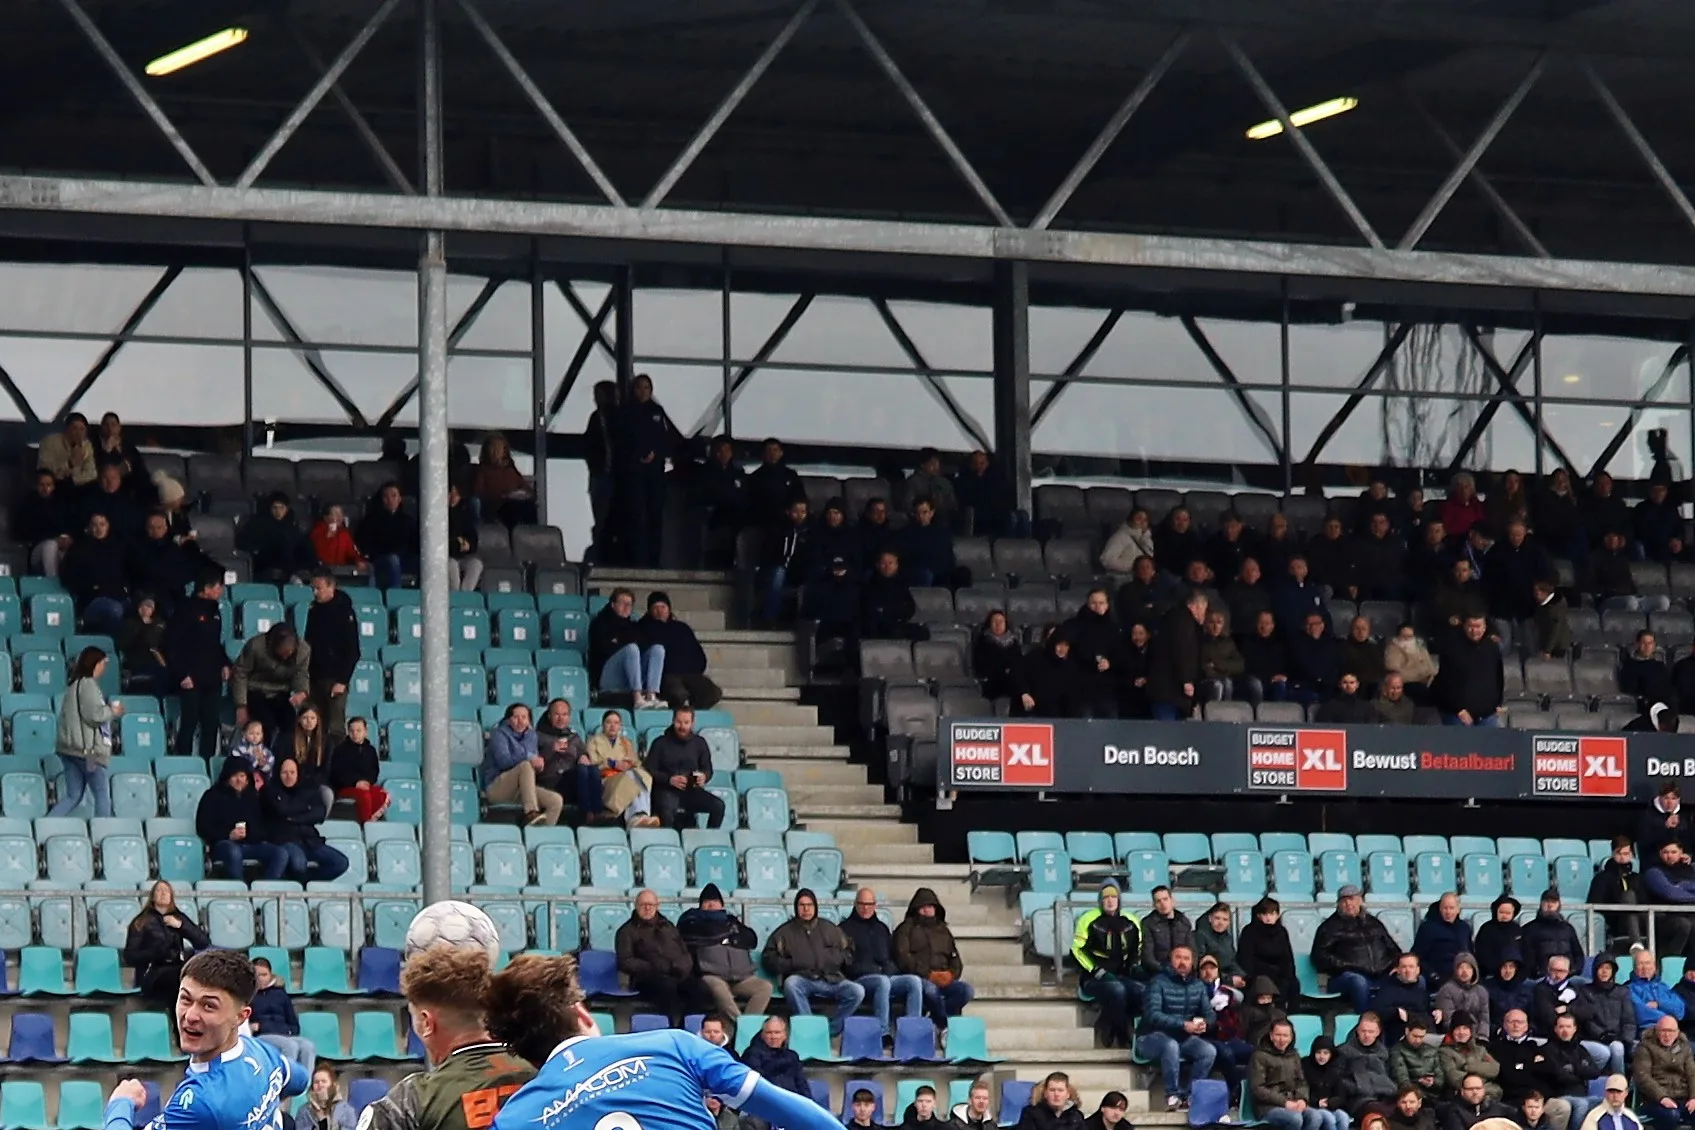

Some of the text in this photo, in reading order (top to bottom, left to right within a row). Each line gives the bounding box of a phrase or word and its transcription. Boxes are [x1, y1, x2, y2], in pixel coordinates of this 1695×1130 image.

[955, 728, 999, 740] BUDGET
[1252, 733, 1295, 746] BUDGET
[955, 747, 1000, 761] HOME
[1536, 740, 1578, 753] BUDGET
[1007, 743, 1049, 767] XL
[1104, 744, 1200, 766] Den Bosch
[1252, 751, 1295, 766] HOME
[1301, 748, 1342, 771] XL
[1353, 750, 1515, 771] Bewust Betaalbaar!
[1536, 758, 1578, 772] HOME
[1583, 755, 1624, 778] XL
[1646, 757, 1681, 776] Den
[955, 766, 1000, 781] STORE
[1252, 770, 1295, 785] STORE
[1536, 777, 1578, 791] STORE
